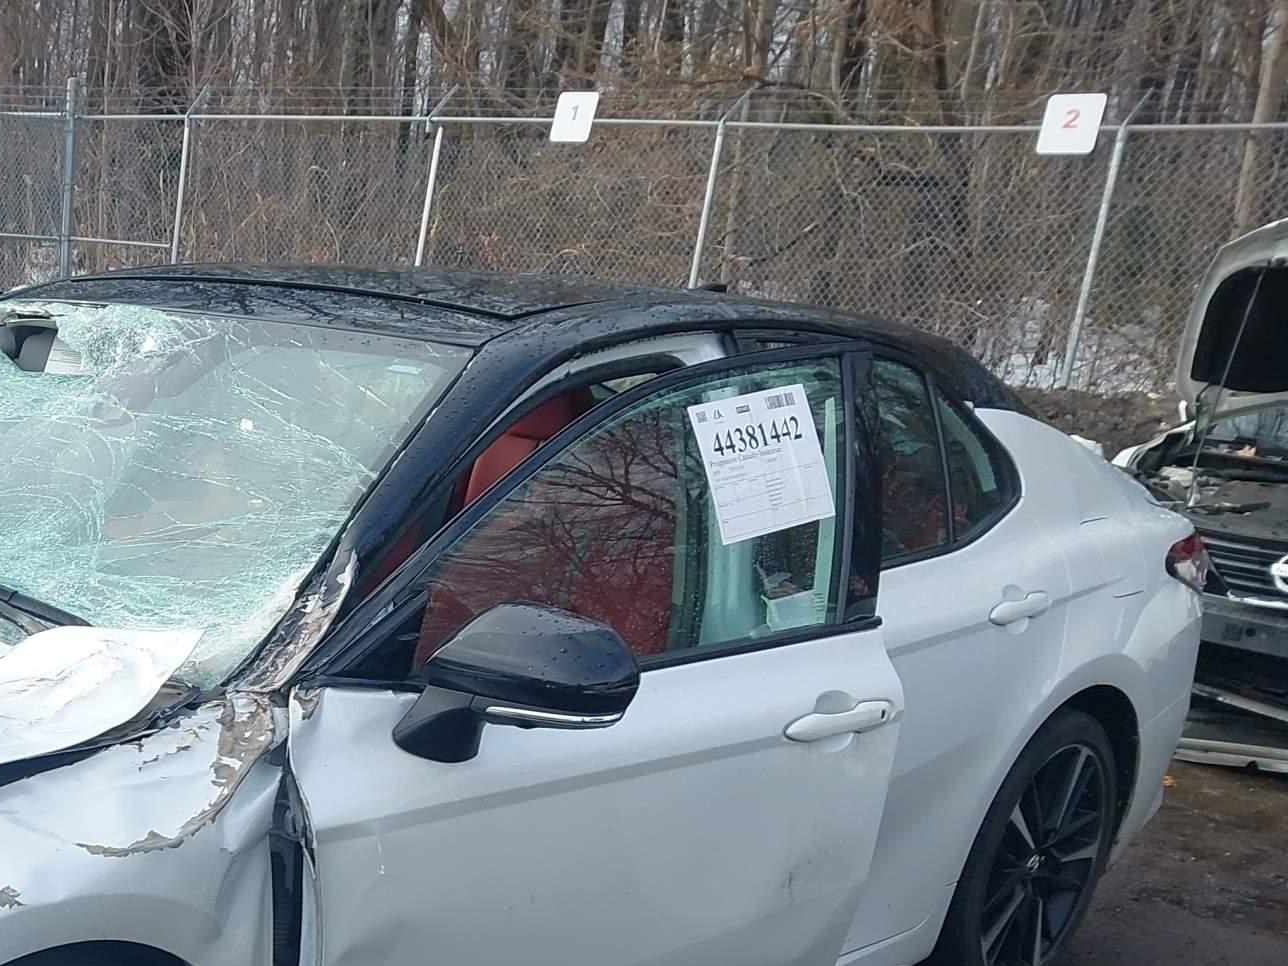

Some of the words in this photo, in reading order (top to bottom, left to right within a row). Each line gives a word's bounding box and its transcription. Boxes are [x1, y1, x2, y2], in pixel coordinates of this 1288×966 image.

[571, 104, 580, 120] 1
[1062, 109, 1080, 128] 2
[713, 416, 802, 456] 44381442
